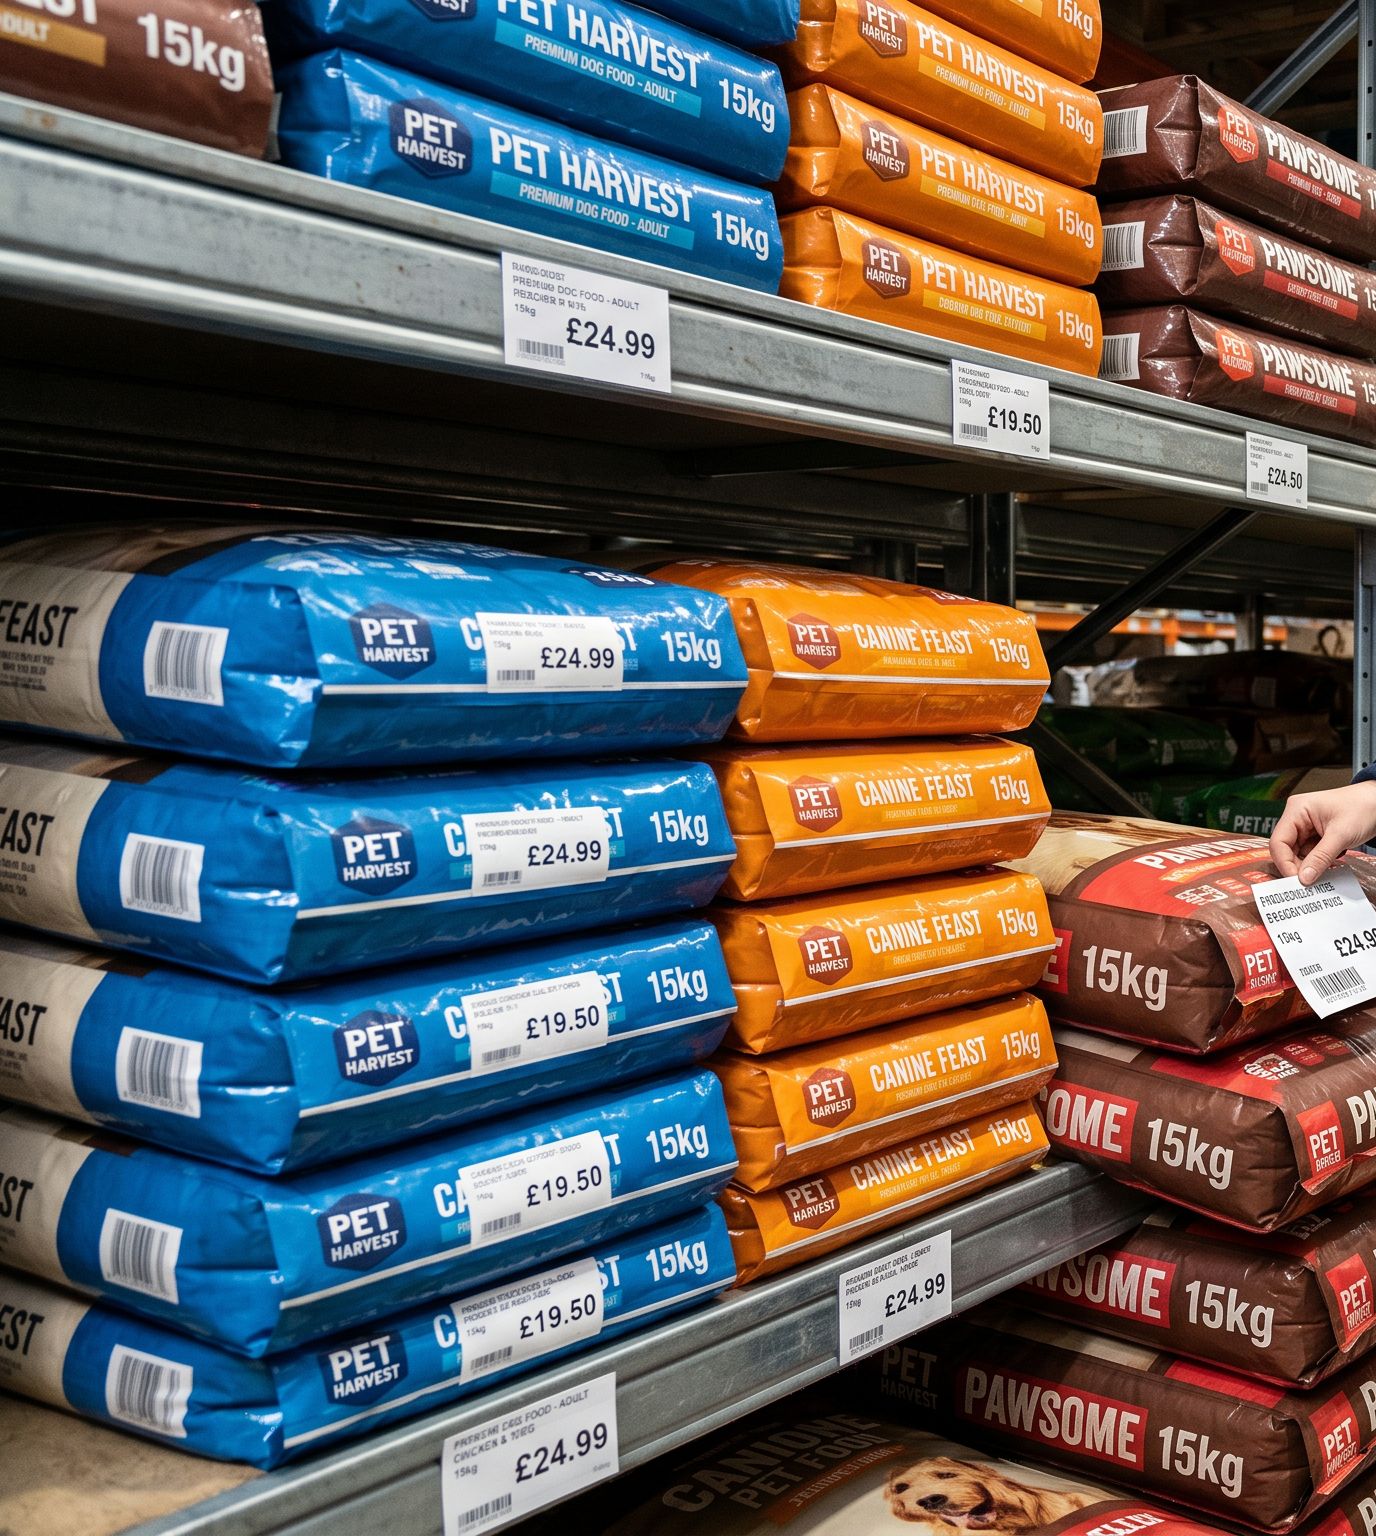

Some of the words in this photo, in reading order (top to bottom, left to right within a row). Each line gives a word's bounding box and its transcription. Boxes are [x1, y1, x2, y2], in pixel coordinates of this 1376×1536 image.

[866, 1, 899, 33] PET
[1056, 0, 1094, 39] 15kg
[137, 12, 246, 92] 15kg
[568, 8, 701, 89] HARVEST
[917, 20, 954, 63] PET
[961, 43, 1047, 108] HARVEST
[524, 34, 579, 67] PREMIUM
[580, 56, 604, 76] DOG
[606, 65, 635, 88] FOOD
[644, 81, 677, 104] ADULT
[719, 78, 775, 133] 15kg
[1057, 101, 1095, 144] 15kg
[405, 108, 458, 148] PET
[870, 127, 899, 157] PET
[1225, 111, 1250, 138] PET
[397, 136, 466, 170] HARVEST
[1262, 124, 1362, 200] PAWSOME
[489, 127, 551, 180] PET
[560, 148, 693, 223] HARVEST
[920, 143, 956, 180] PET
[961, 160, 1046, 217] HARVEST
[519, 183, 574, 212] PREMIUM
[576, 201, 600, 219] DOG
[600, 208, 629, 229] FOOD
[637, 218, 670, 239] ADULT
[1056, 206, 1094, 249] 15kg
[711, 209, 770, 262] 15kg
[1222, 226, 1248, 252] PET
[868, 244, 901, 273] PET
[1259, 235, 1359, 302] PAWSOME
[866, 270, 907, 289] HARVEST
[921, 255, 958, 291] PET
[964, 272, 1046, 320] HARVEST
[515, 303, 536, 317] 15kg
[579, 290, 604, 303] FOOD
[612, 298, 640, 311] ADULT
[566, 317, 655, 359] £24.99
[1056, 310, 1094, 348] 15kg
[1222, 335, 1246, 358] PET
[1257, 340, 1356, 398] PAWSOME
[988, 406, 1042, 435] £19.50
[1268, 467, 1302, 489] £24.50
[360, 618, 419, 645] PET
[661, 629, 723, 670] 15kg
[795, 625, 829, 643] PET
[852, 623, 921, 652] CANINE
[923, 628, 973, 655] FEAST
[363, 646, 431, 664] HARVEST
[540, 646, 616, 670] £24.99
[989, 638, 1030, 669] 15kg
[795, 786, 831, 808] PET
[855, 777, 922, 807] CANINE
[927, 773, 974, 800] FEAST
[990, 774, 1030, 804] 15kg
[649, 809, 710, 847] 15kg
[799, 806, 838, 821] HARVEST
[342, 832, 403, 863] PET
[527, 840, 602, 867] £24.99
[342, 862, 412, 882] HARVEST
[866, 919, 932, 954] CANINE
[935, 910, 983, 941] FEAST
[997, 907, 1038, 937] 15kg
[805, 935, 841, 961] PET
[808, 958, 849, 974] HARVEST
[1244, 948, 1273, 976] PET
[647, 966, 709, 1005] 15kg
[1082, 944, 1169, 1012] 15kg
[344, 1020, 405, 1058] PET
[526, 1004, 600, 1041] £19.50
[345, 1048, 415, 1076] HARVEST
[1001, 1029, 1041, 1060] 15kg
[869, 1054, 936, 1093] CANINE
[939, 1035, 987, 1074] FEAST
[808, 1077, 845, 1105] PET
[811, 1098, 852, 1120] HARVEST
[646, 1123, 709, 1164] 15kg
[988, 1116, 1033, 1148] 15kg
[1309, 1125, 1338, 1158] PET
[850, 1153, 919, 1191] CANINE
[923, 1127, 976, 1166] FEAST
[1148, 1118, 1234, 1190] 15kg
[527, 1164, 603, 1208] £19.50
[785, 1178, 829, 1209] PET
[327, 1201, 391, 1245] PET
[793, 1199, 836, 1223] HARVEST
[331, 1228, 400, 1262] HARVEST
[646, 1240, 709, 1283] 15kg
[885, 1273, 945, 1318] £24.99
[1185, 1280, 1275, 1348] 15kg
[1340, 1278, 1366, 1316] PET
[519, 1293, 597, 1340] £19.50
[330, 1334, 392, 1382] PET
[333, 1363, 401, 1399] HARVEST
[525, 1405, 552, 1422] FOOD
[559, 1389, 589, 1408] ADULT
[964, 1366, 1141, 1464] PAWSOME
[515, 1422, 608, 1483] £24.99
[1322, 1416, 1353, 1460] PET
[1158, 1424, 1245, 1498] 15kg
